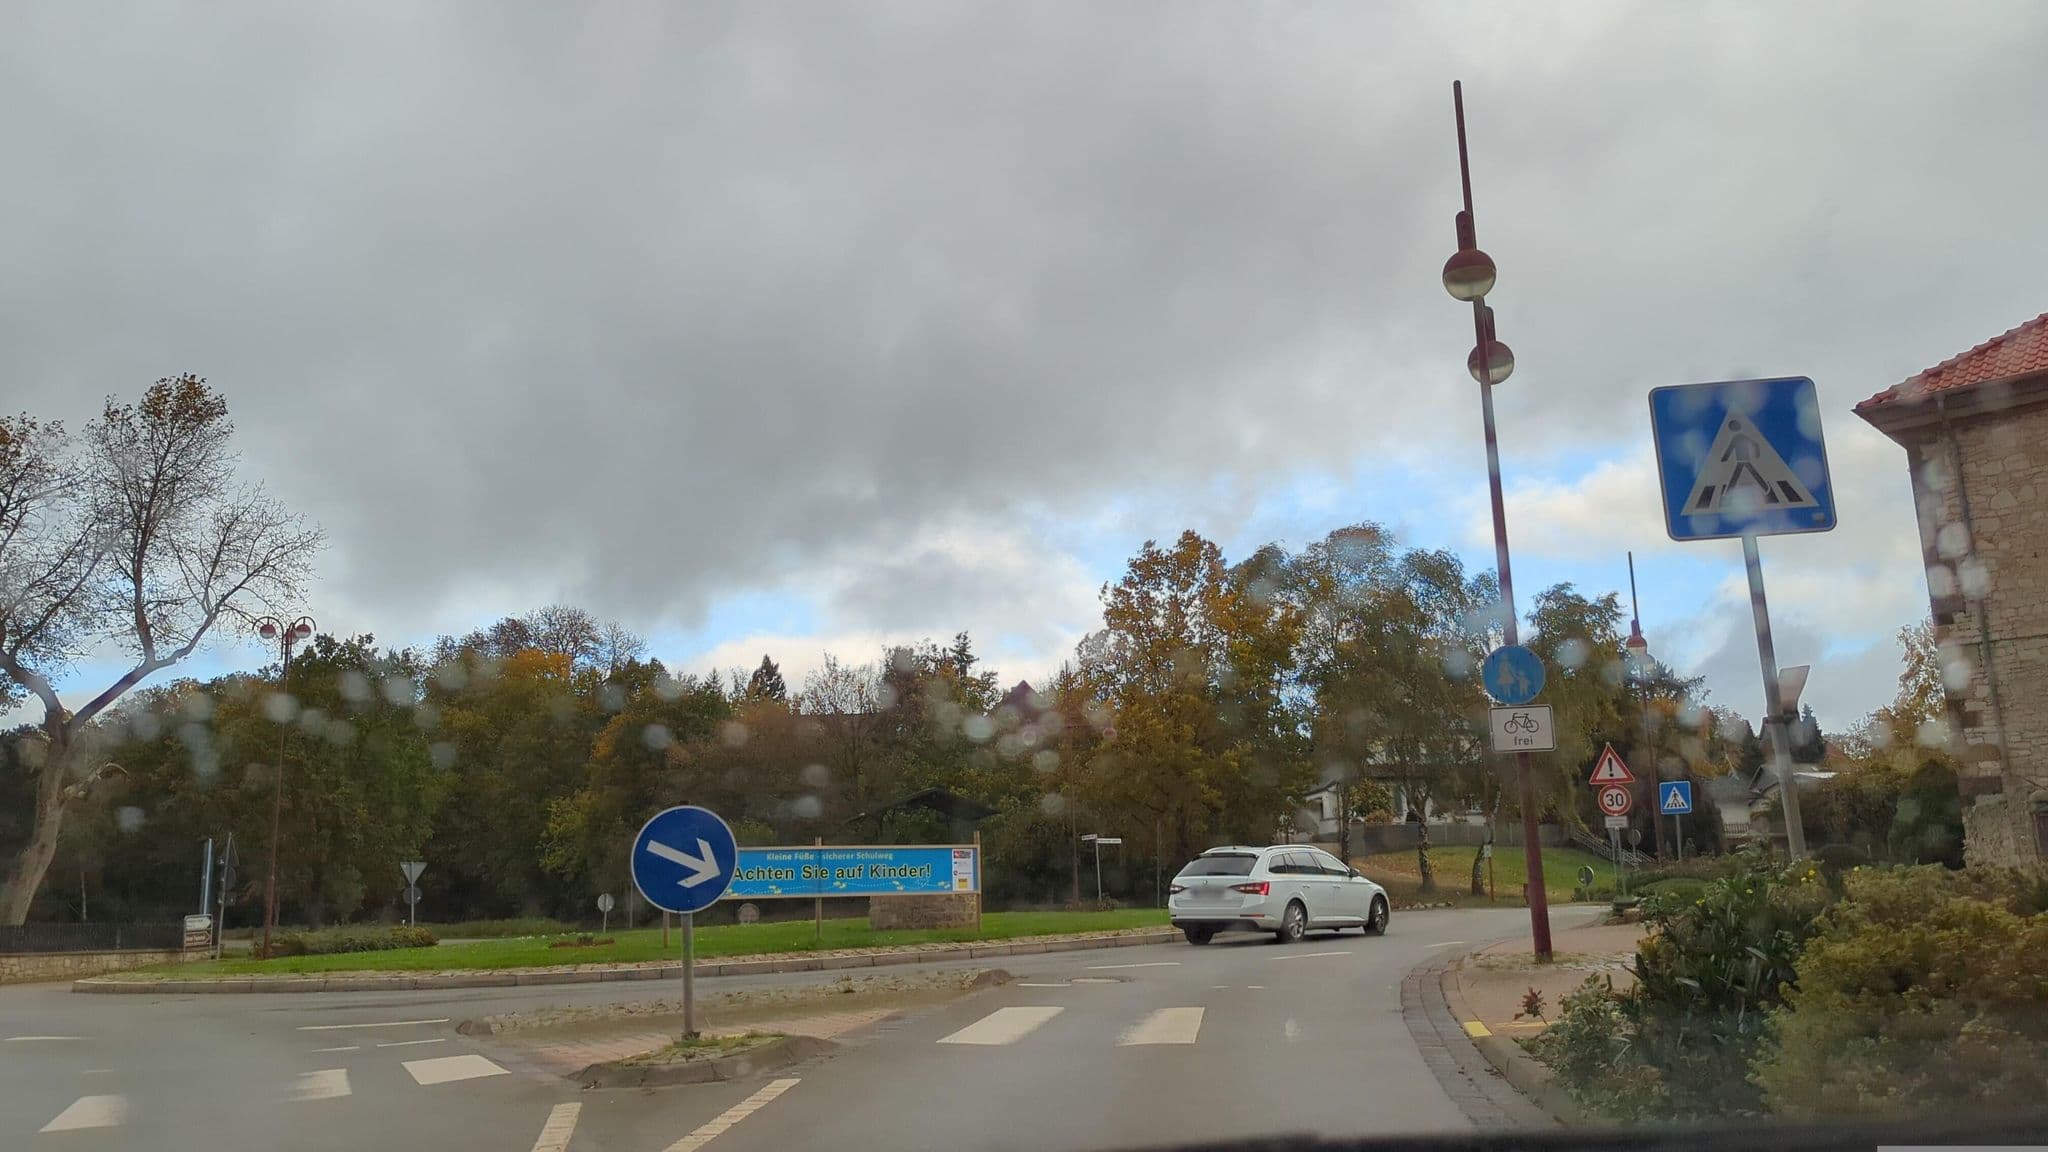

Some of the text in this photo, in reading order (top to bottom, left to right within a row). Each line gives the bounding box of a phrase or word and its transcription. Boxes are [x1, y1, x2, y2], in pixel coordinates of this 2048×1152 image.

[1514, 736, 1533, 746] frei
[1606, 793, 1624, 807] 30
[766, 851, 792, 861] Kleine
[794, 851, 814, 861] Füße
[822, 851, 855, 861] sicherer
[856, 850, 893, 861] Schulweg
[734, 863, 932, 880] Achten Sie auf Kinder!
